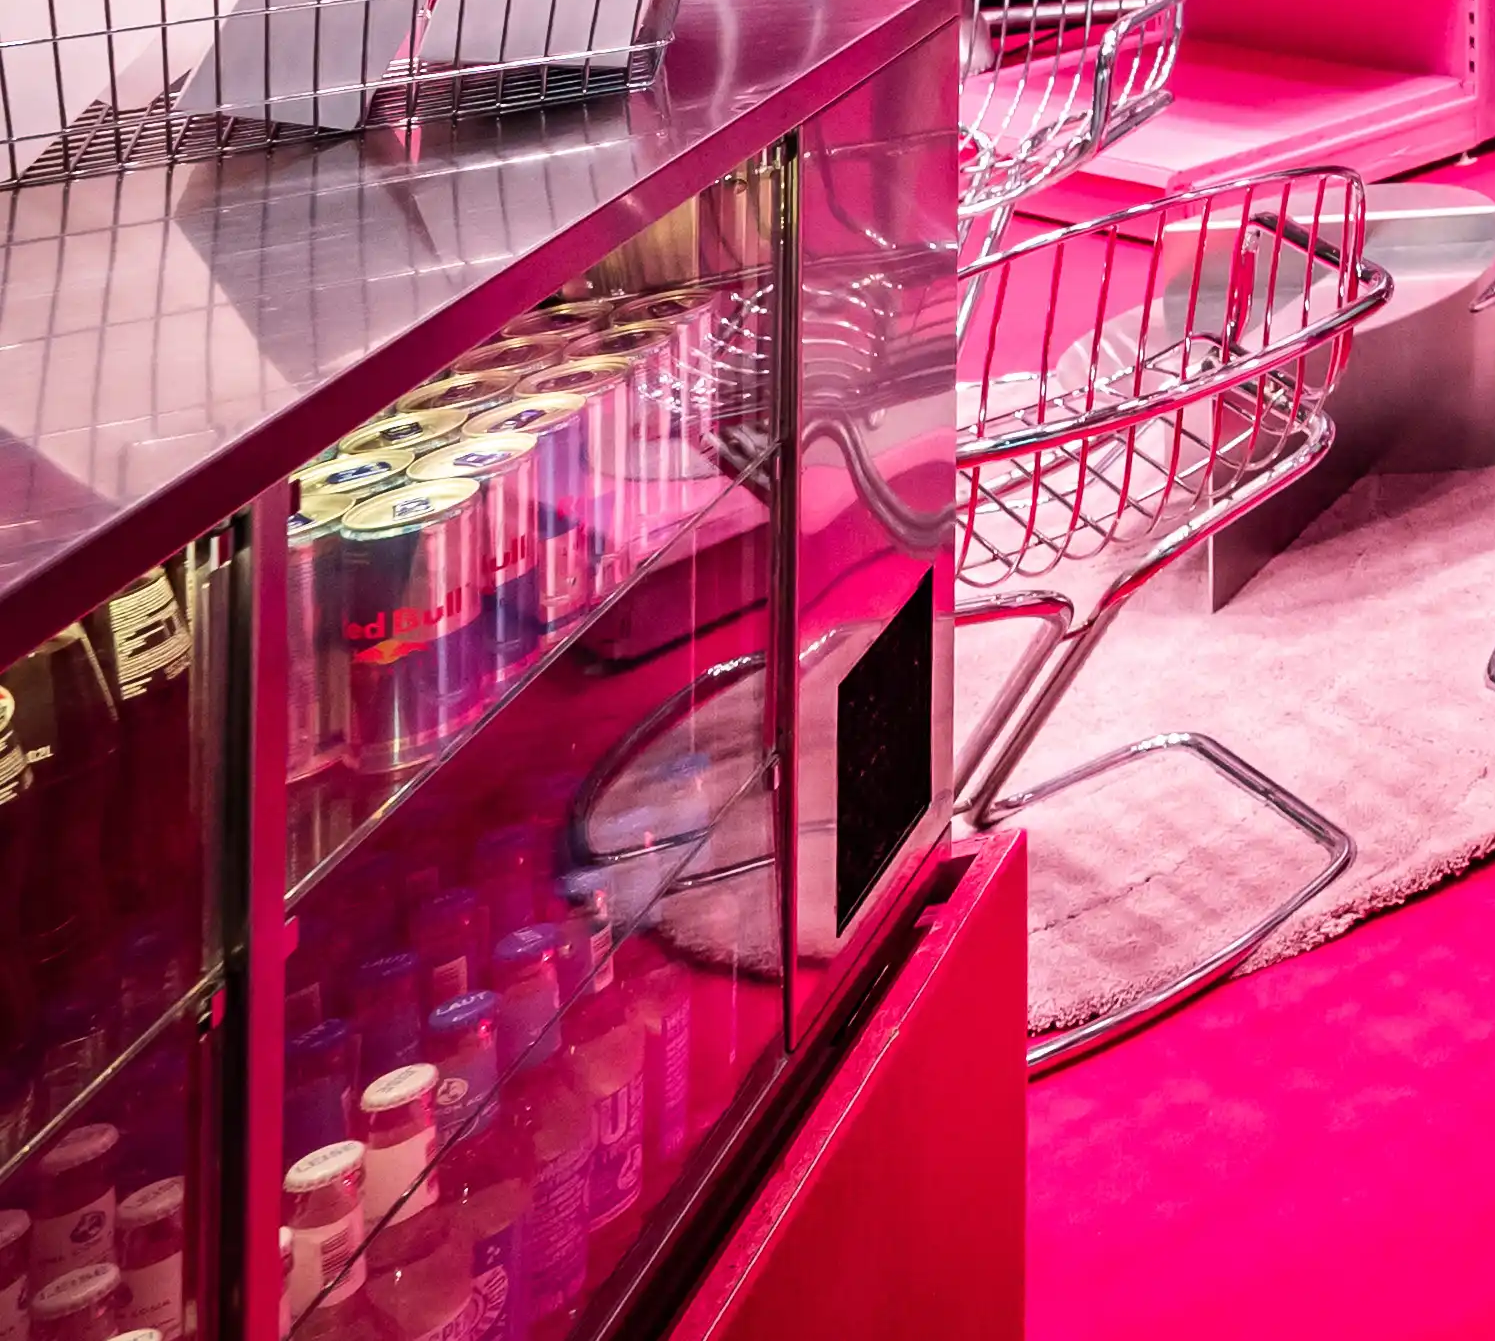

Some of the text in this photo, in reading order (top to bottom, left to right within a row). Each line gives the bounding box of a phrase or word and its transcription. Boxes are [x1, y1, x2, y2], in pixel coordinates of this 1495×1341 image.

[342, 587, 463, 640] ed Bull
[436, 990, 489, 1016] LAUT
